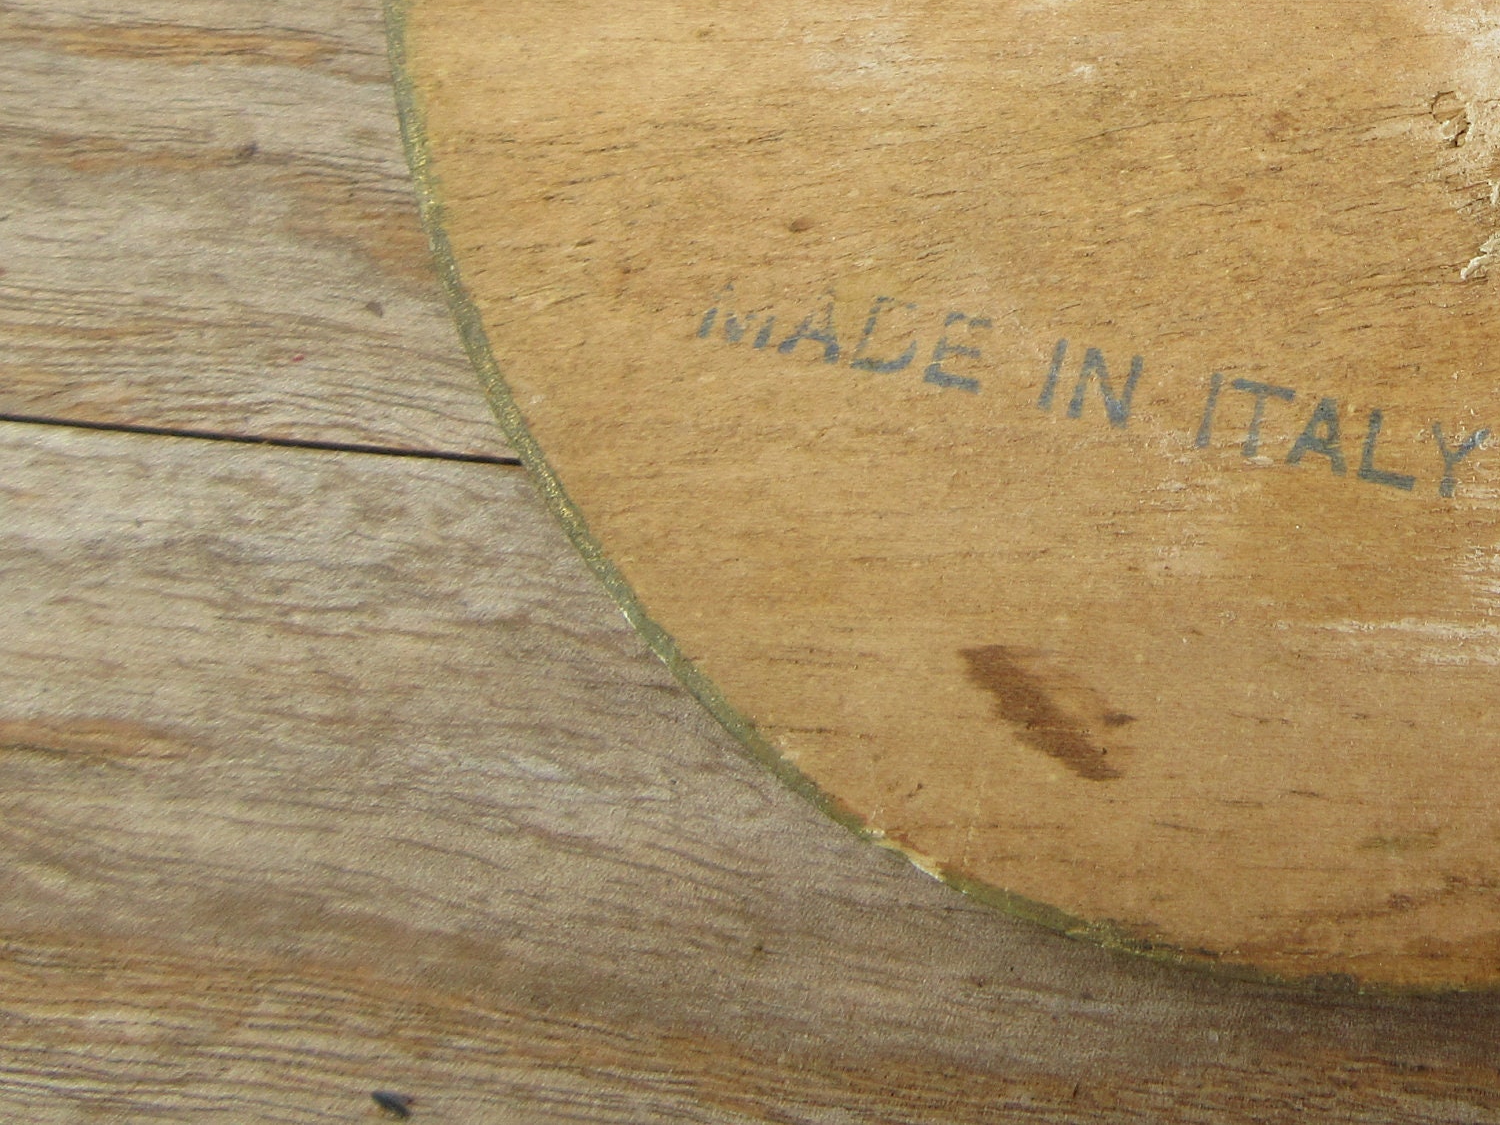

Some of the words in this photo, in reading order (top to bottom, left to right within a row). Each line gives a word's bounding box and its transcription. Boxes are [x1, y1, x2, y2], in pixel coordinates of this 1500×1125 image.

[696, 283, 992, 394] MADE
[1037, 338, 1144, 429] IN
[1196, 373, 1490, 498] ITALY
